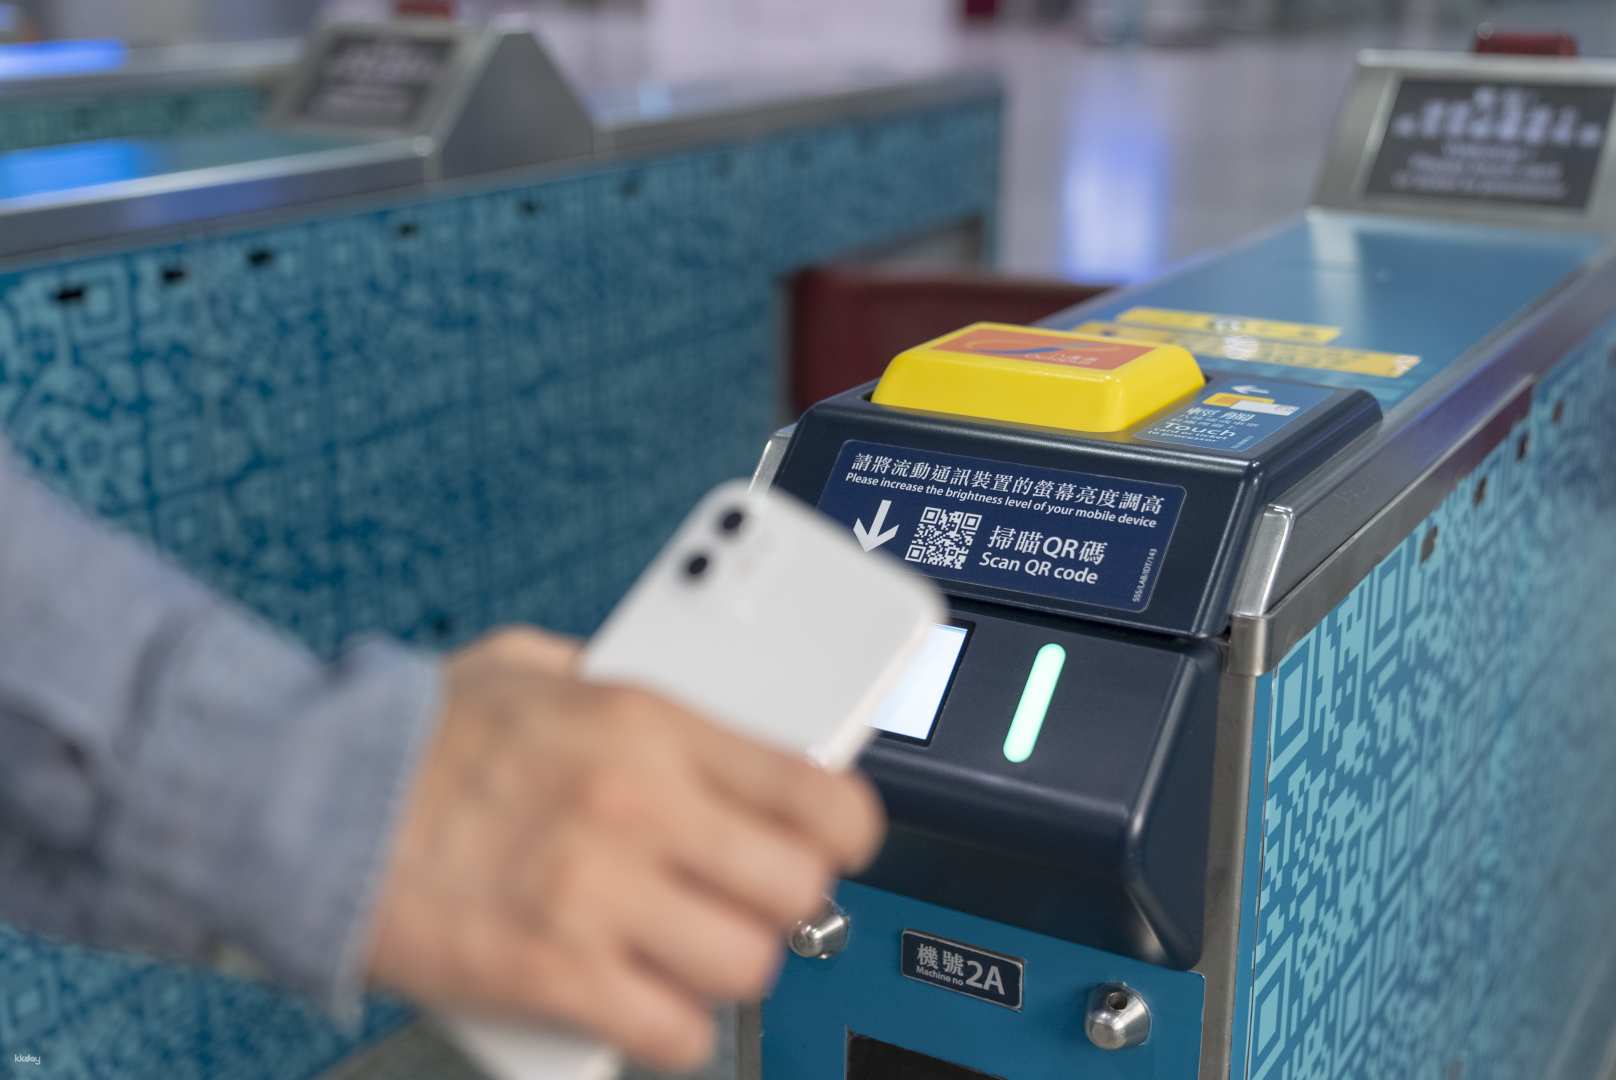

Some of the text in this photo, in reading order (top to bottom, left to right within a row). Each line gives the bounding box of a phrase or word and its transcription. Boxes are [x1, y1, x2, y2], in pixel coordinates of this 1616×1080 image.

[1165, 421, 1235, 437] Touch
[845, 472, 1157, 528] Please increase the brightness level of your mobile device
[851, 453, 1164, 515] 請將流動通訊裝置的螢幕亮度調高
[987, 525, 1108, 565] 掃瞄QR碼
[979, 551, 1099, 585] Scan QR code
[915, 965, 952, 983] Machine
[917, 943, 1006, 996] 機號 2A
